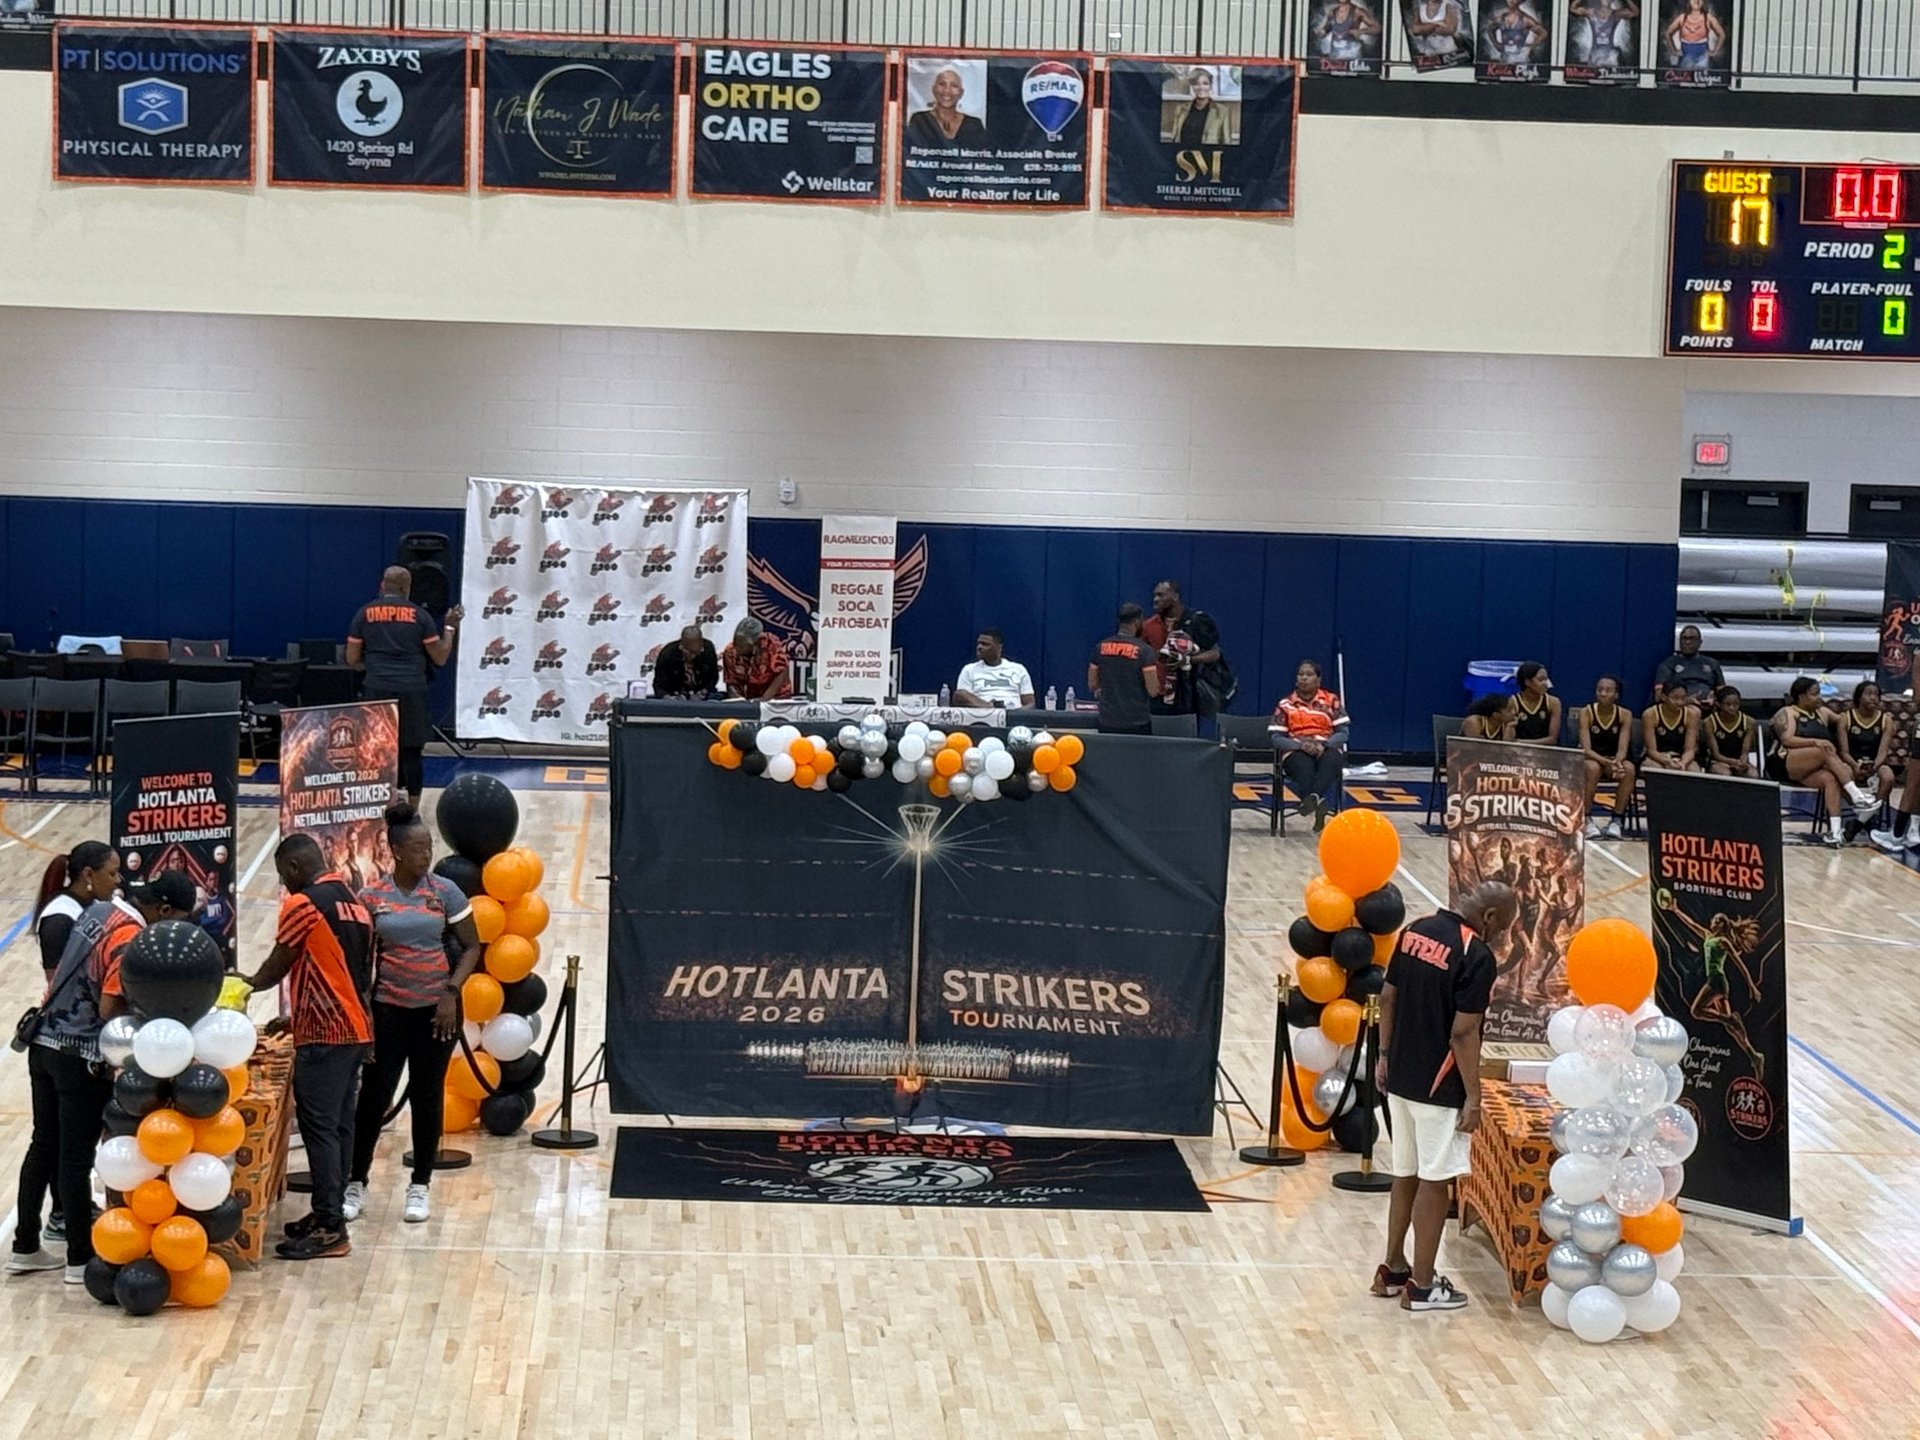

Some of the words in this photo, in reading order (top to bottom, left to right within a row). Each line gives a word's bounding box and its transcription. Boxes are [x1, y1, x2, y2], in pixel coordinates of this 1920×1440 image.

[63, 48, 92, 72] PT
[104, 50, 241, 75] SOLUTIONS
[317, 46, 422, 73] ZAXBY'S
[704, 49, 832, 80] EAGLES
[702, 83, 821, 112] ORTHO
[1029, 80, 1078, 96] RE/MAX
[609, 90, 664, 129] Wade
[702, 115, 790, 144] CARE
[63, 140, 153, 158] PHYSICAL
[161, 142, 243, 160] THERAPY
[326, 140, 355, 153] 1420
[357, 140, 396, 157] Spring
[398, 141, 414, 155] Rd
[996, 149, 1043, 159] Associate
[1045, 150, 1078, 160] Broker
[347, 154, 392, 170] Smyrna
[807, 176, 874, 192] Wellstar
[1194, 187, 1242, 197] MITCHELL
[1704, 171, 1772, 193] GUEST
[928, 187, 958, 199] Your
[962, 188, 1008, 200] Realtor
[1013, 189, 1031, 201] for
[1035, 189, 1061, 201] Life
[1834, 172, 1899, 218] 0.0
[1730, 197, 1770, 245] 17
[1803, 242, 1874, 259] PERIOD
[1883, 234, 1905, 269] 2
[1685, 279, 1732, 292] FOULS
[1751, 280, 1779, 293] TOL
[1811, 282, 1914, 296] PLAYER-FOUL
[1700, 295, 1723, 331] 0
[1752, 297, 1774, 332] 0
[1883, 300, 1905, 335] 0
[1679, 335, 1734, 348] POINTS
[1810, 338, 1864, 351] MATCH
[831, 583, 884, 596] REGGAE
[365, 606, 417, 623] UMPIRE
[838, 600, 875, 612] SOCA
[822, 617, 890, 630] AFROBEAT
[834, 650, 853, 658] FIND
[867, 650, 881, 659] ON
[304, 772, 345, 787] WELCOME
[345, 770, 357, 783] TO
[357, 769, 380, 781] 2026
[1479, 762, 1520, 775] WELCOME
[1521, 767, 1533, 776] TO
[141, 775, 195, 790] WELCOME
[197, 772, 213, 786] TO
[1476, 776, 1561, 803] HOTLANTA
[138, 787, 217, 810] HOTLANTA
[290, 788, 342, 809] HOTLANTA
[343, 783, 391, 804] STRIKERS
[127, 804, 228, 833] STRIKERS
[294, 810, 330, 828] NETBALL
[120, 831, 163, 848] NETBALL
[164, 826, 233, 843] TOURNAMENT
[1660, 832, 1764, 866] HOTLANTA
[1661, 856, 1765, 890] STRIKERS
[1673, 881, 1723, 897] SPORTING
[1726, 889, 1752, 901] CLUB
[663, 965, 889, 1000] HOTLANTA
[942, 969, 1151, 1016] STRIKERS
[739, 1005, 826, 1023] 2026
[950, 1009, 1121, 1037] TOURNAMENT
[1483, 1021, 1500, 1034] One
[1501, 1024, 1521, 1036] Goal
[1689, 1036, 1731, 1058] Champions
[1683, 1053, 1699, 1069] One
[1701, 1057, 1721, 1074] Goal
[1692, 1073, 1712, 1089] Time
[777, 1142, 1014, 1159] STRIKERS
